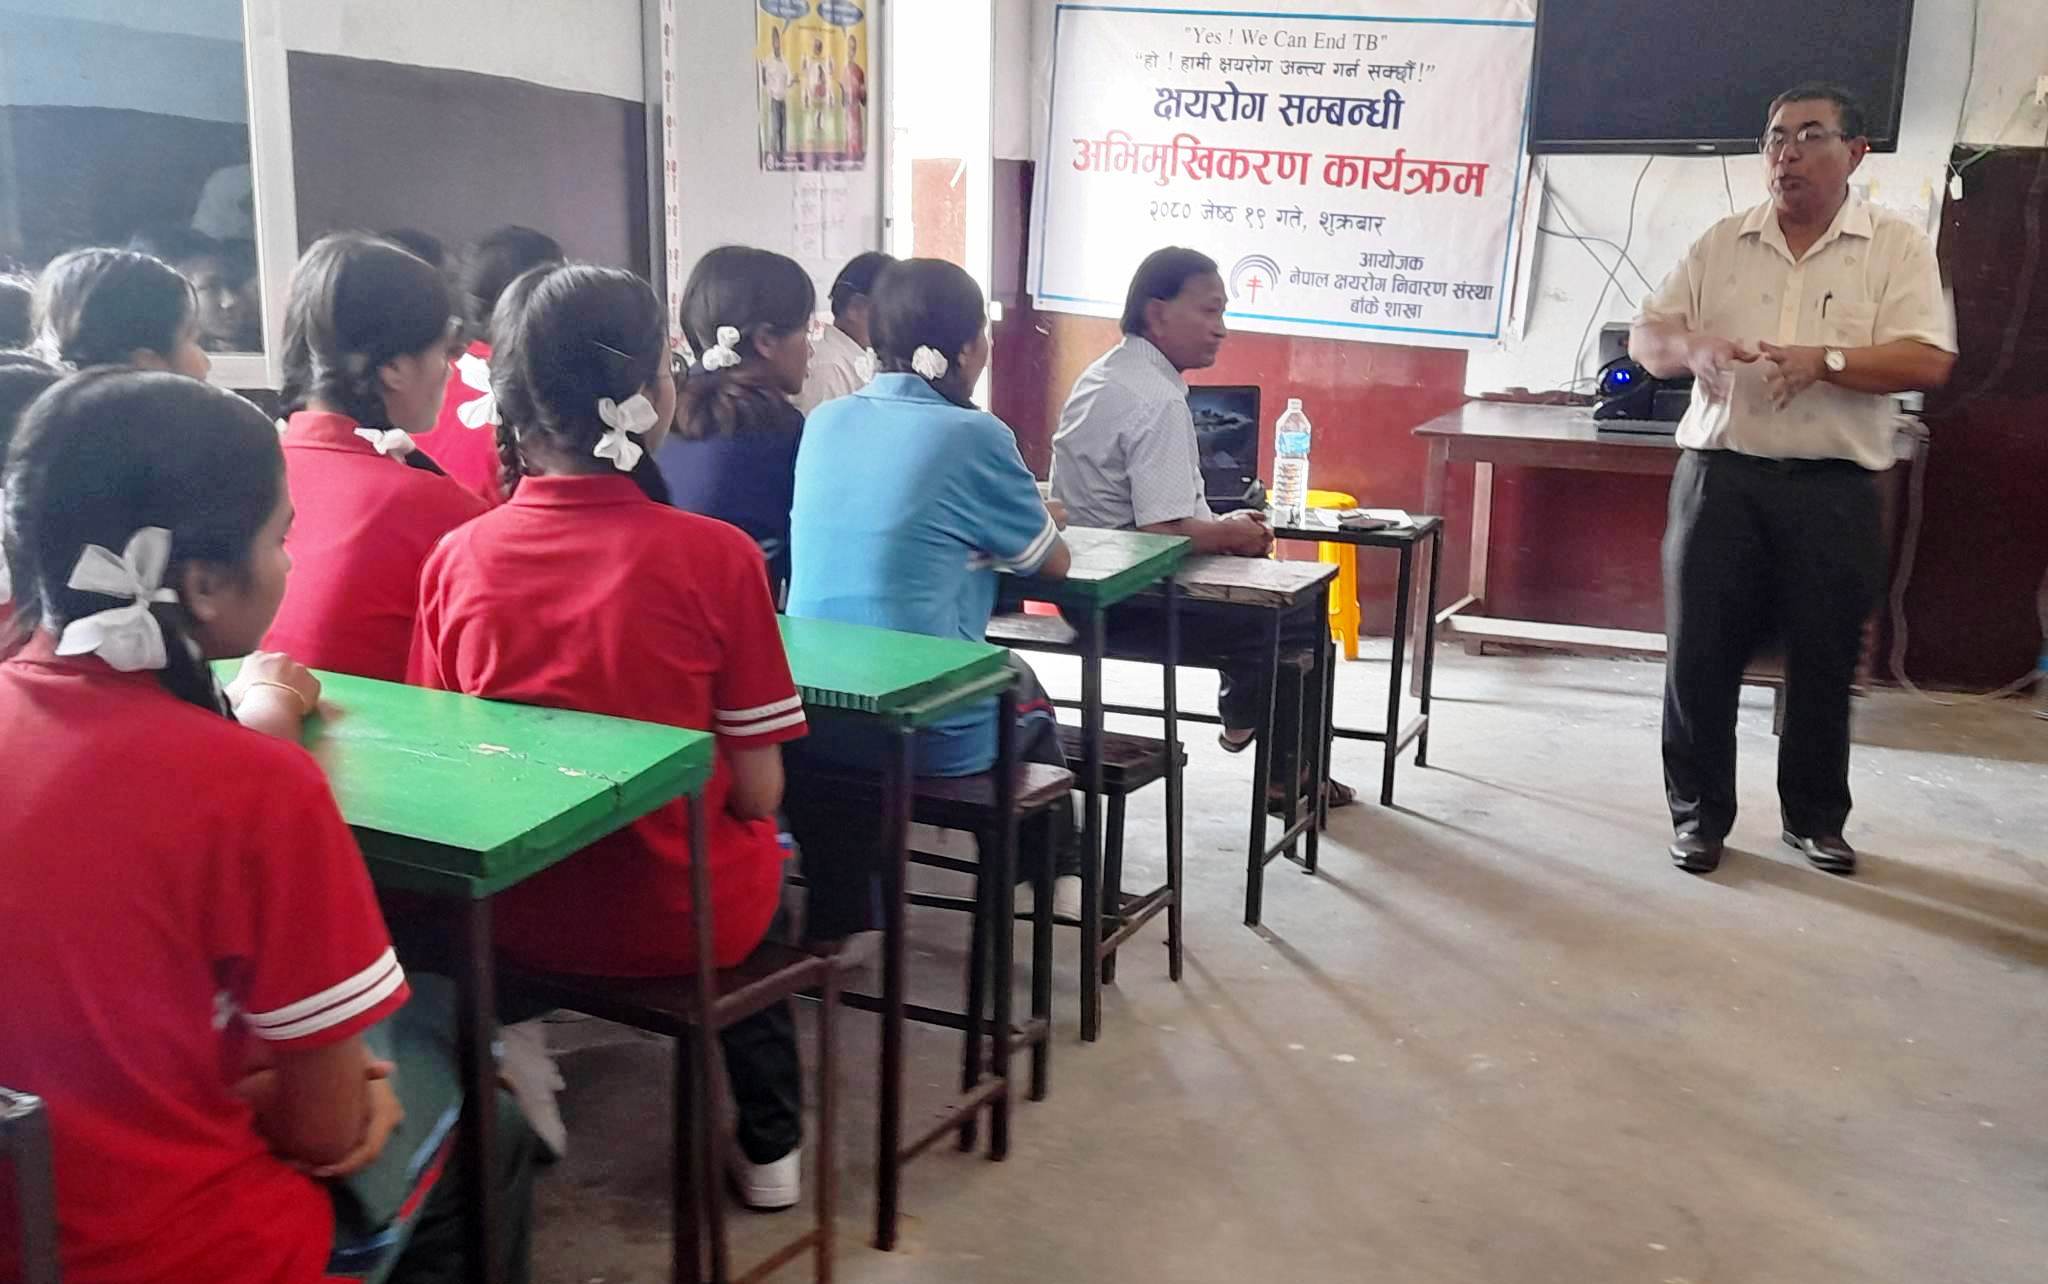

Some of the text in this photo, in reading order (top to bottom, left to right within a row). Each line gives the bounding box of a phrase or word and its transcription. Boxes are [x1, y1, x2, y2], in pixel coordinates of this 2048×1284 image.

[1185, 26, 1222, 44] "Yes
[1241, 28, 1269, 46] We
[1274, 30, 1307, 48] Can
[1314, 31, 1346, 50] End
[1353, 33, 1388, 51] TB"
[1181, 52, 1212, 73] हामी
[1219, 54, 1273, 75] क्षयरोग
[1333, 58, 1360, 78] गर्न
[1153, 81, 1405, 130] क्षयरोग सम्बन्धी
[1072, 129, 1489, 197] अभिमुखिकरण कार्यक्रम
[1149, 200, 1191, 222] २०८०
[1245, 207, 1266, 229] १९
[1277, 205, 1307, 232] गते,
[1359, 249, 1425, 271] आयोजक
[1289, 266, 1495, 301] नेपाल क्षयरोग निवारण संस्था
[1384, 301, 1424, 319] शाखा
